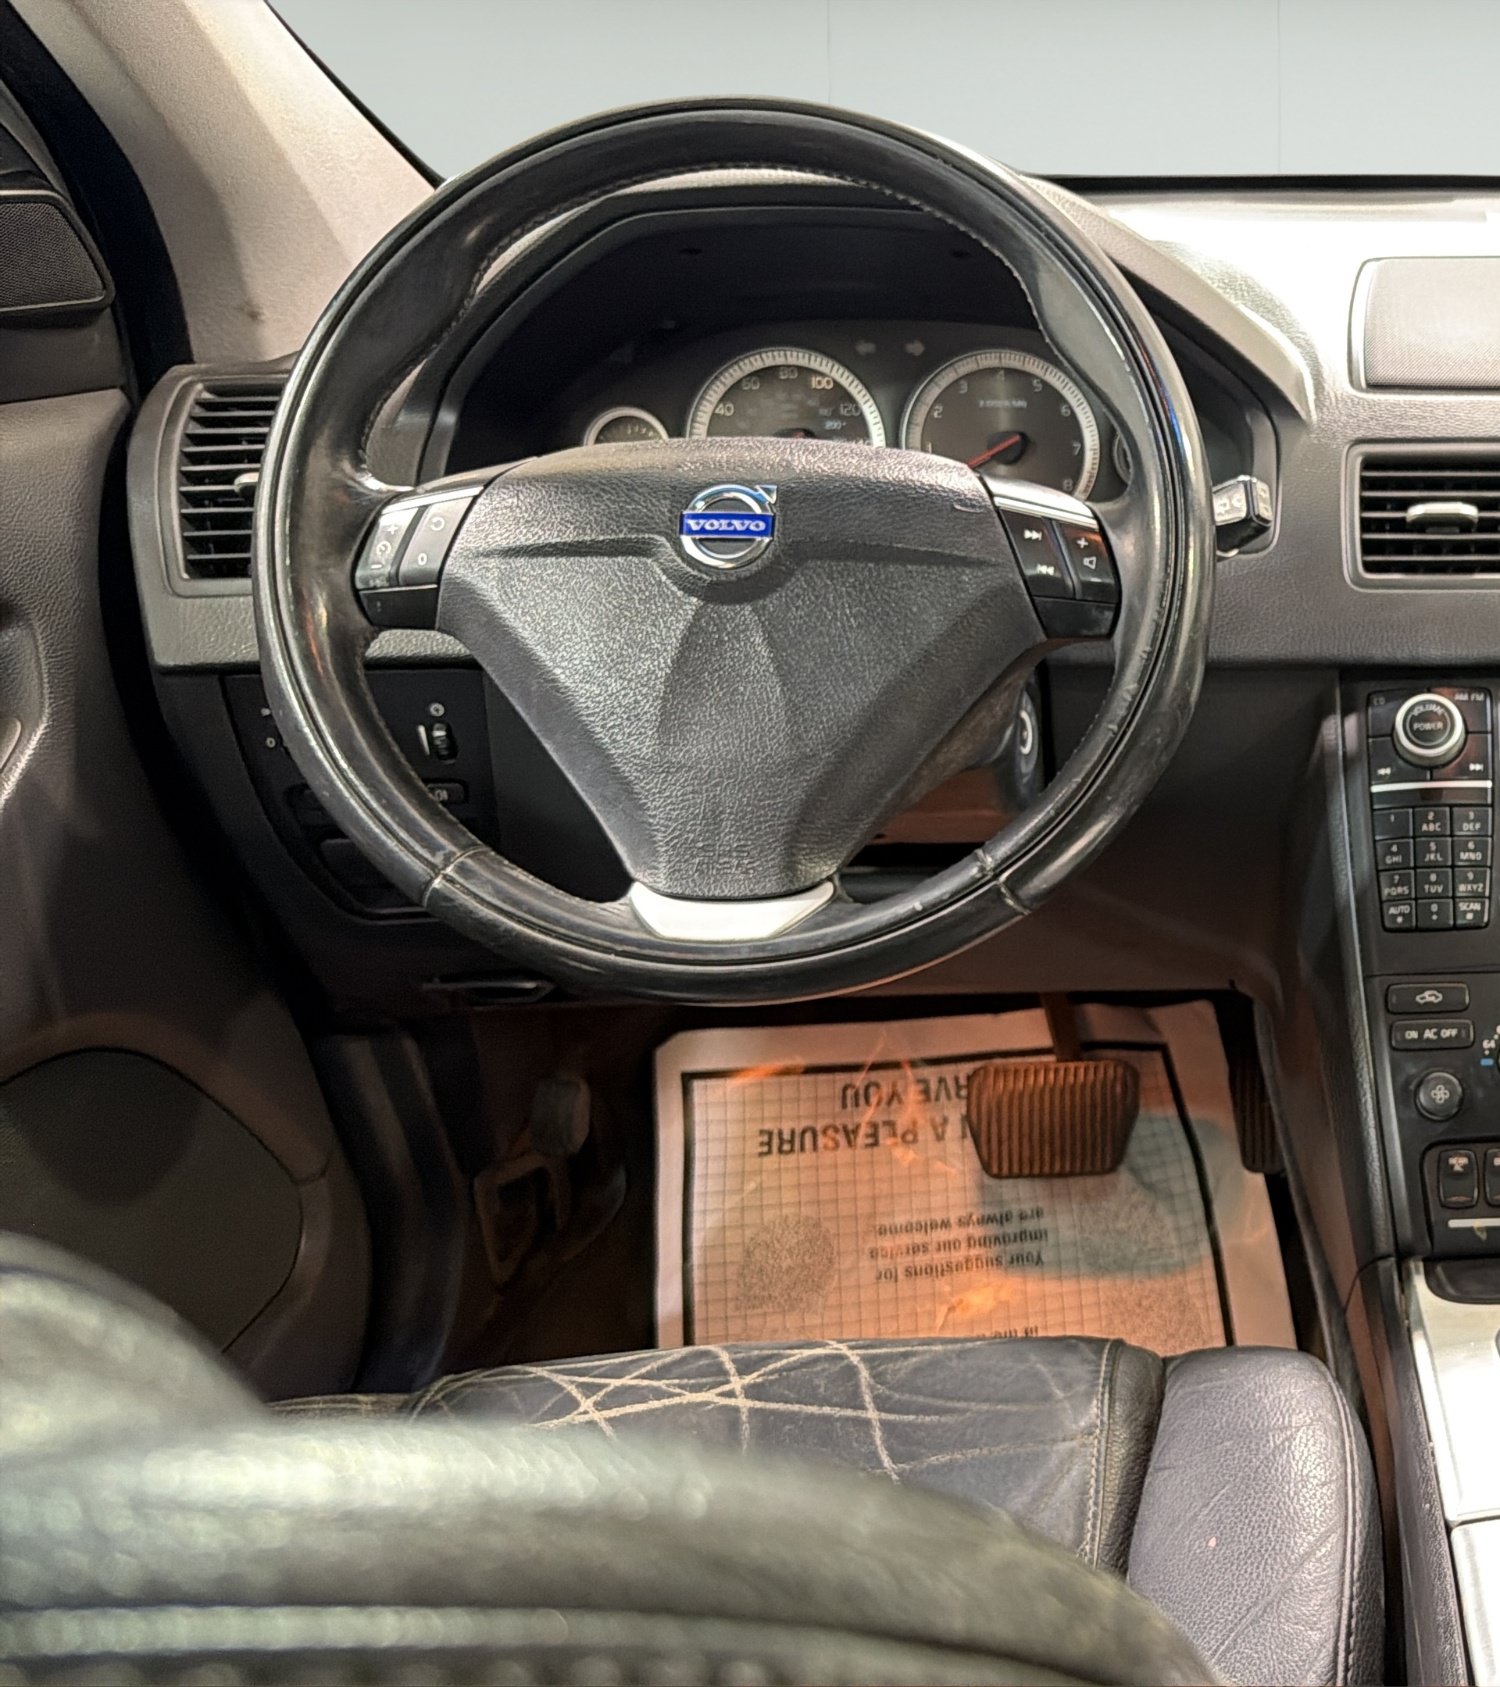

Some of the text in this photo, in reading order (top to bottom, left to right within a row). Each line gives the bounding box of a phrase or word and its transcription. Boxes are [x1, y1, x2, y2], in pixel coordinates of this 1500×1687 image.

[779, 367, 798, 379] 80
[742, 377, 760, 390] 60
[810, 376, 834, 390] 100
[958, 379, 968, 393] 3
[1032, 379, 1043, 392] 5
[715, 403, 734, 416] 40
[840, 403, 861, 416] 120
[933, 405, 943, 419] 2
[1061, 405, 1071, 417] 6
[1072, 441, 1082, 456] 7
[1062, 479, 1073, 492] 8
[687, 519, 766, 531] VOLVO
[1471, 693, 1485, 701] FM
[1411, 703, 1445, 716] VOLUME
[1413, 721, 1443, 731] POWER
[1390, 814, 1395, 822] 1
[1427, 811, 1434, 820] 2
[1468, 811, 1475, 820] 3
[1421, 822, 1441, 832] ABC
[1462, 823, 1481, 831] DEF
[1391, 844, 1398, 852] 4
[1429, 842, 1436, 851] 5
[1467, 841, 1475, 850] 6
[1385, 855, 1402, 864] GHI
[1424, 852, 1443, 862] JKL
[1460, 851, 1482, 860] MNO
[1393, 875, 1400, 884] 7
[1429, 873, 1437, 882] 8
[1467, 872, 1474, 881] 9
[1384, 885, 1409, 896] PQRS
[1424, 884, 1443, 893] TUV
[1459, 883, 1484, 892] WXYZ
[1388, 905, 1410, 915] AUTO
[1459, 902, 1481, 911] SCAN
[1405, 1029, 1458, 1039] ON AC OFF
[1482, 1039, 1496, 1049] 64
[840, 1080, 905, 1110] YOU
[757, 1119, 919, 1157] PLEASURE
[1019, 1207, 1044, 1221] are
[957, 1210, 1014, 1229] always
[868, 1228, 1048, 1261] improving our service
[875, 1251, 1044, 1283] Your suggestions for
